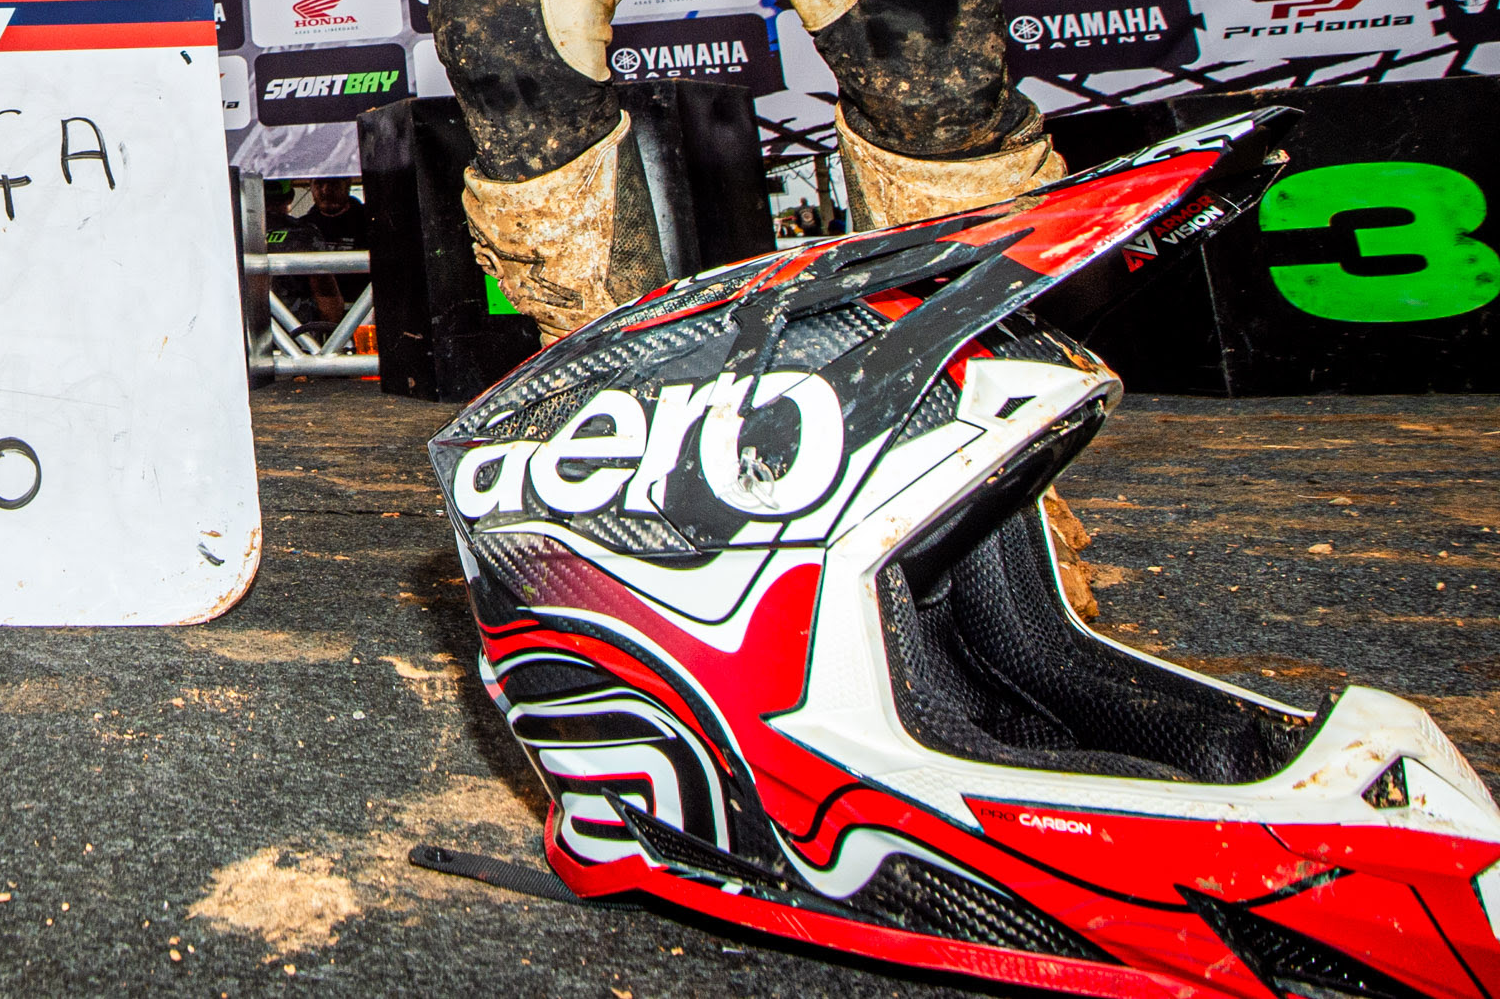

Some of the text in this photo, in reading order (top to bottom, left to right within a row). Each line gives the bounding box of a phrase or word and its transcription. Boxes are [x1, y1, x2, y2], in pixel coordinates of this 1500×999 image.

[294, 15, 358, 28] HONDA
[1041, 6, 1169, 40] YAMAHA
[640, 40, 749, 71] YAMAHA
[1025, 33, 1162, 51] RACING
[263, 70, 400, 100] SPORTBAY
[624, 64, 743, 81] RACING
[1152, 195, 1216, 238] ARMOR
[1161, 205, 1225, 245] VISION
[1259, 162, 1500, 323] 3
[453, 371, 844, 518] aero
[980, 808, 1092, 835] PRO CARBON
